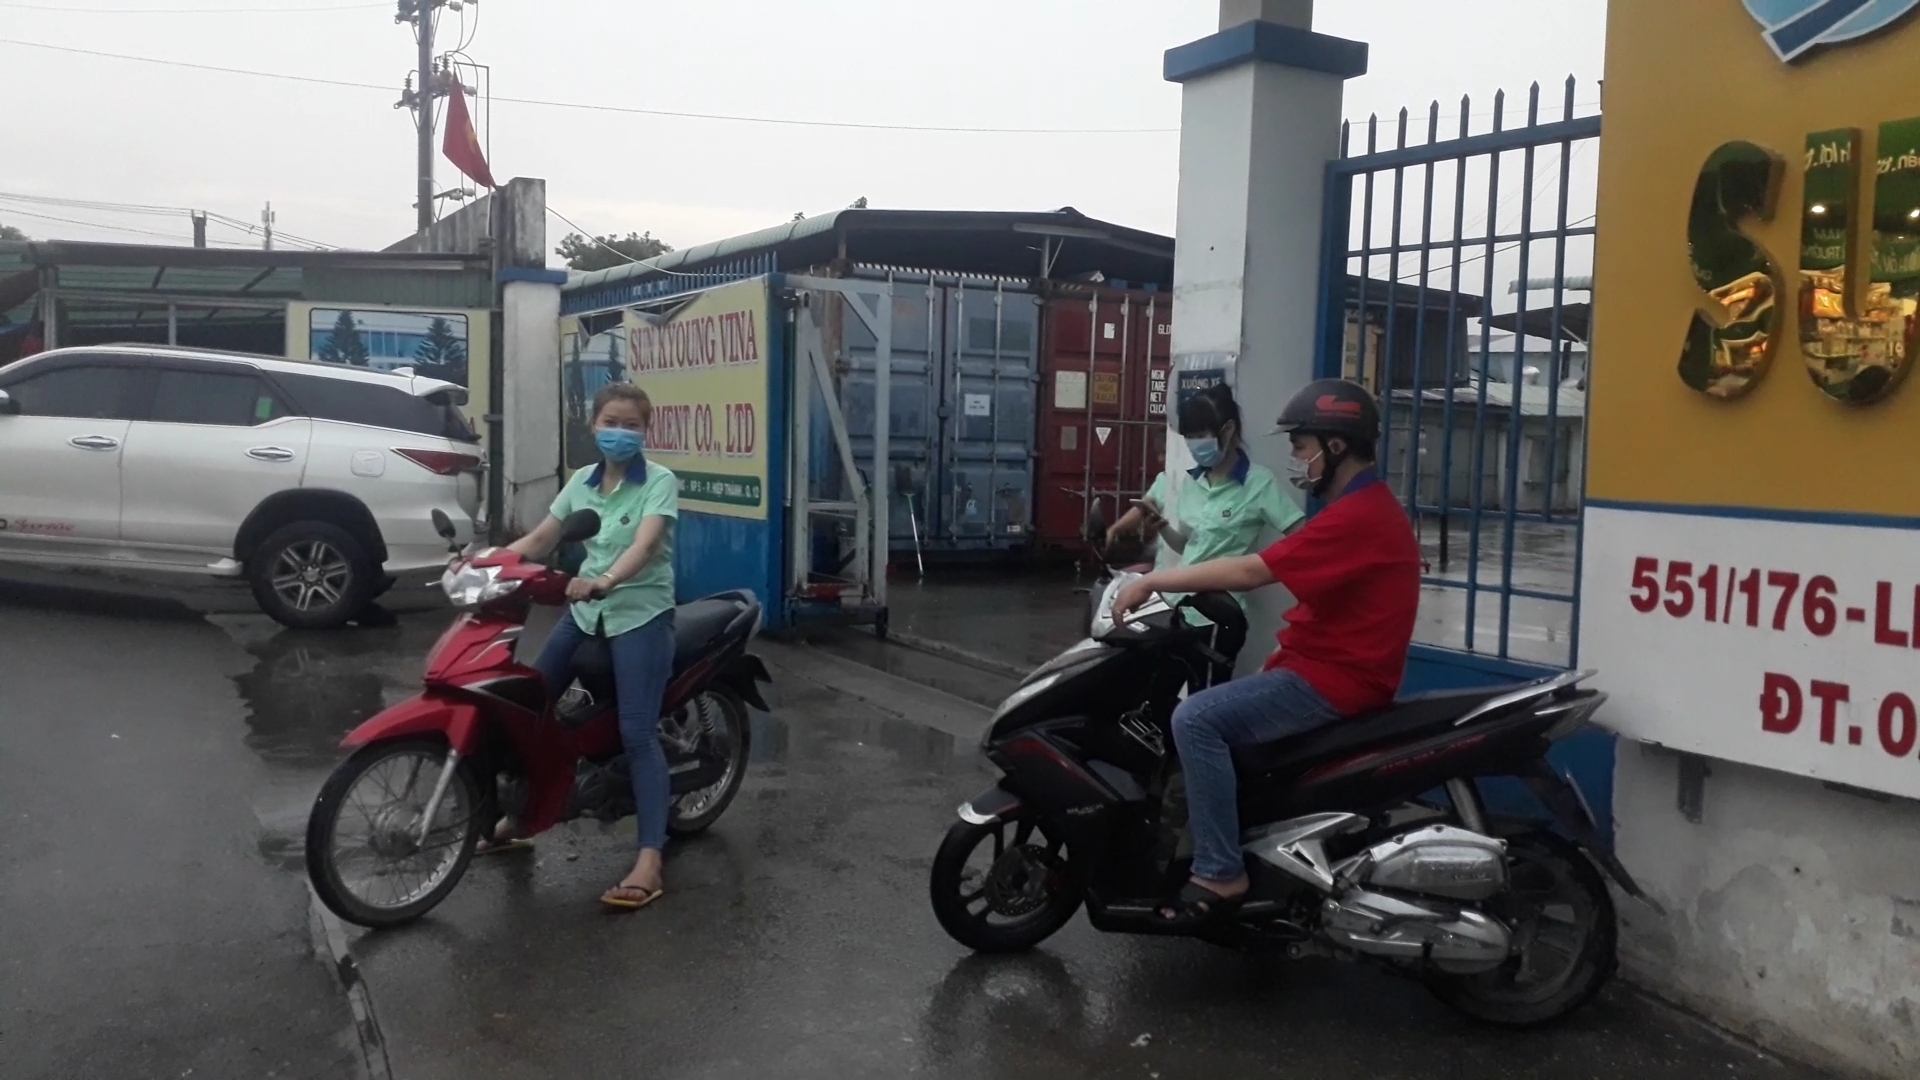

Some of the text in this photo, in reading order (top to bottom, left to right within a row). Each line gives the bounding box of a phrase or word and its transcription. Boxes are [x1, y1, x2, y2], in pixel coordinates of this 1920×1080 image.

[630, 309, 758, 371] SUN KYOUNG VINA
[1151, 381, 1166, 391] TARE
[725, 402, 755, 453] LTD
